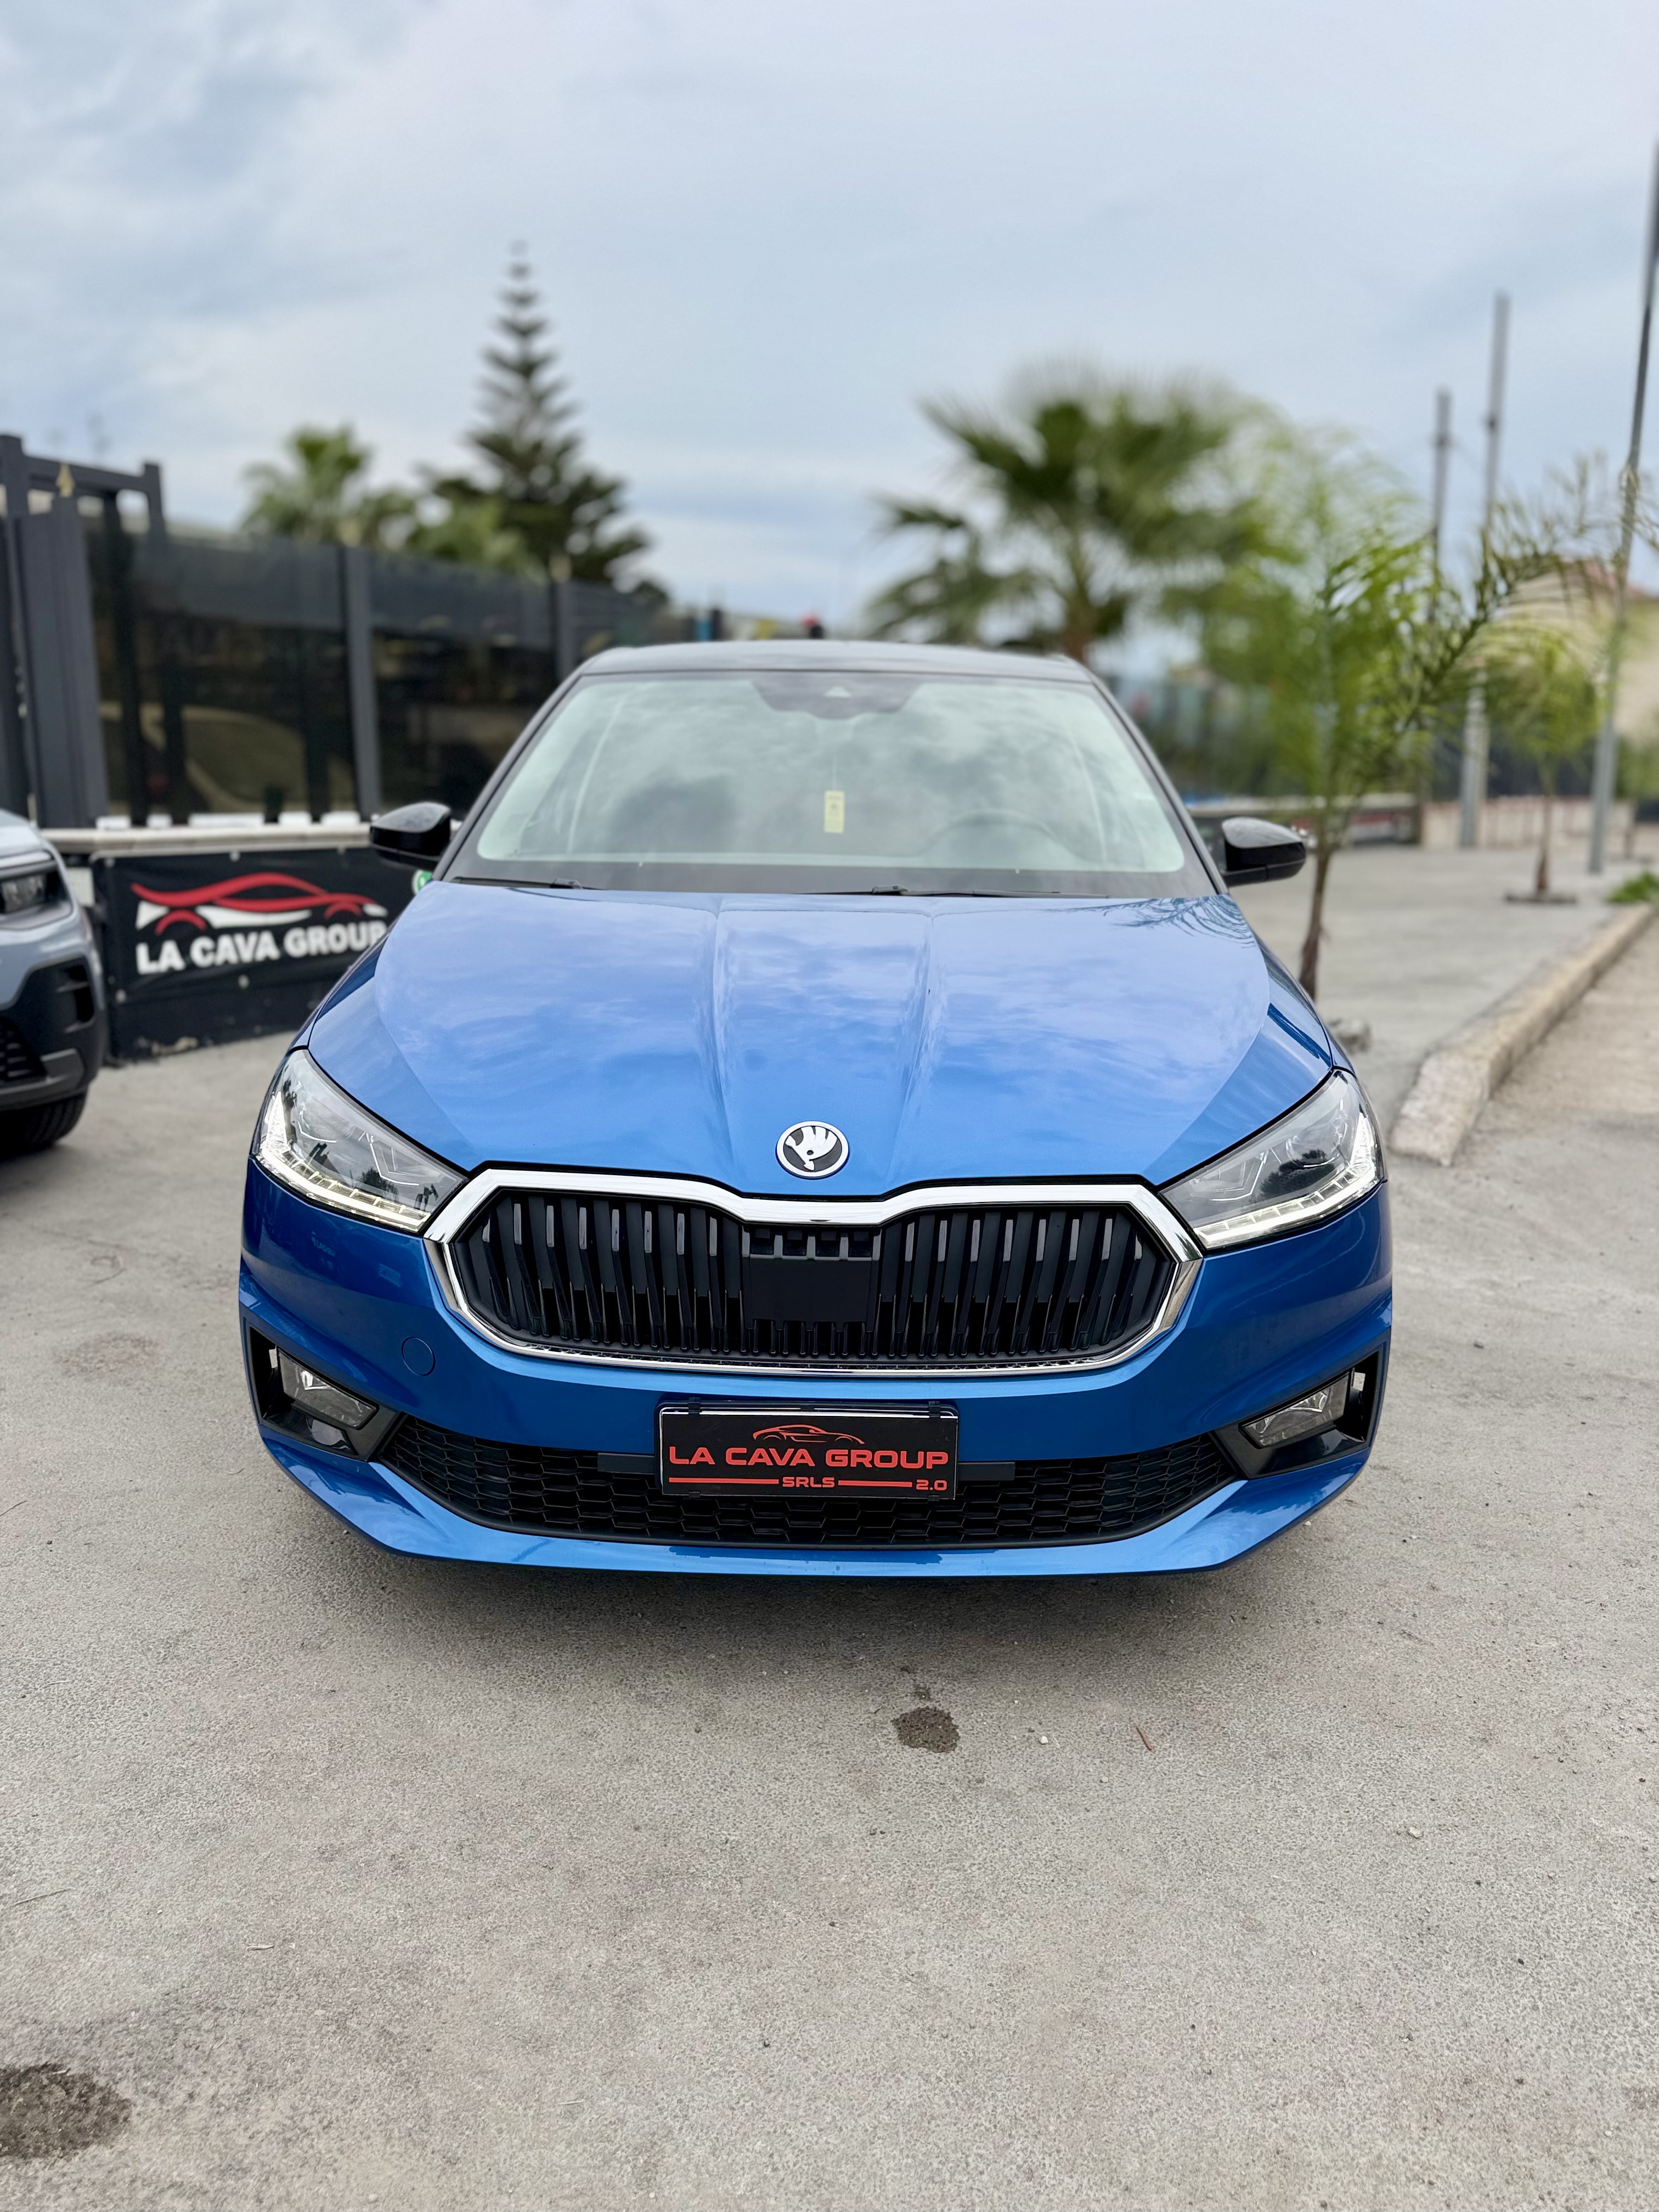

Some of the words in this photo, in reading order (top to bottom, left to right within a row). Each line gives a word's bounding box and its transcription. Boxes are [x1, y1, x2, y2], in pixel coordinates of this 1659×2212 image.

[136, 940, 186, 974] LA
[190, 930, 280, 967] CAVA
[284, 920, 387, 958] GROUP
[669, 1446, 715, 1465] LA
[725, 1447, 816, 1467] CAVA
[825, 1449, 949, 1469] GROUP
[782, 1476, 836, 1488] SRLS
[916, 1479, 948, 1491] 2.0
